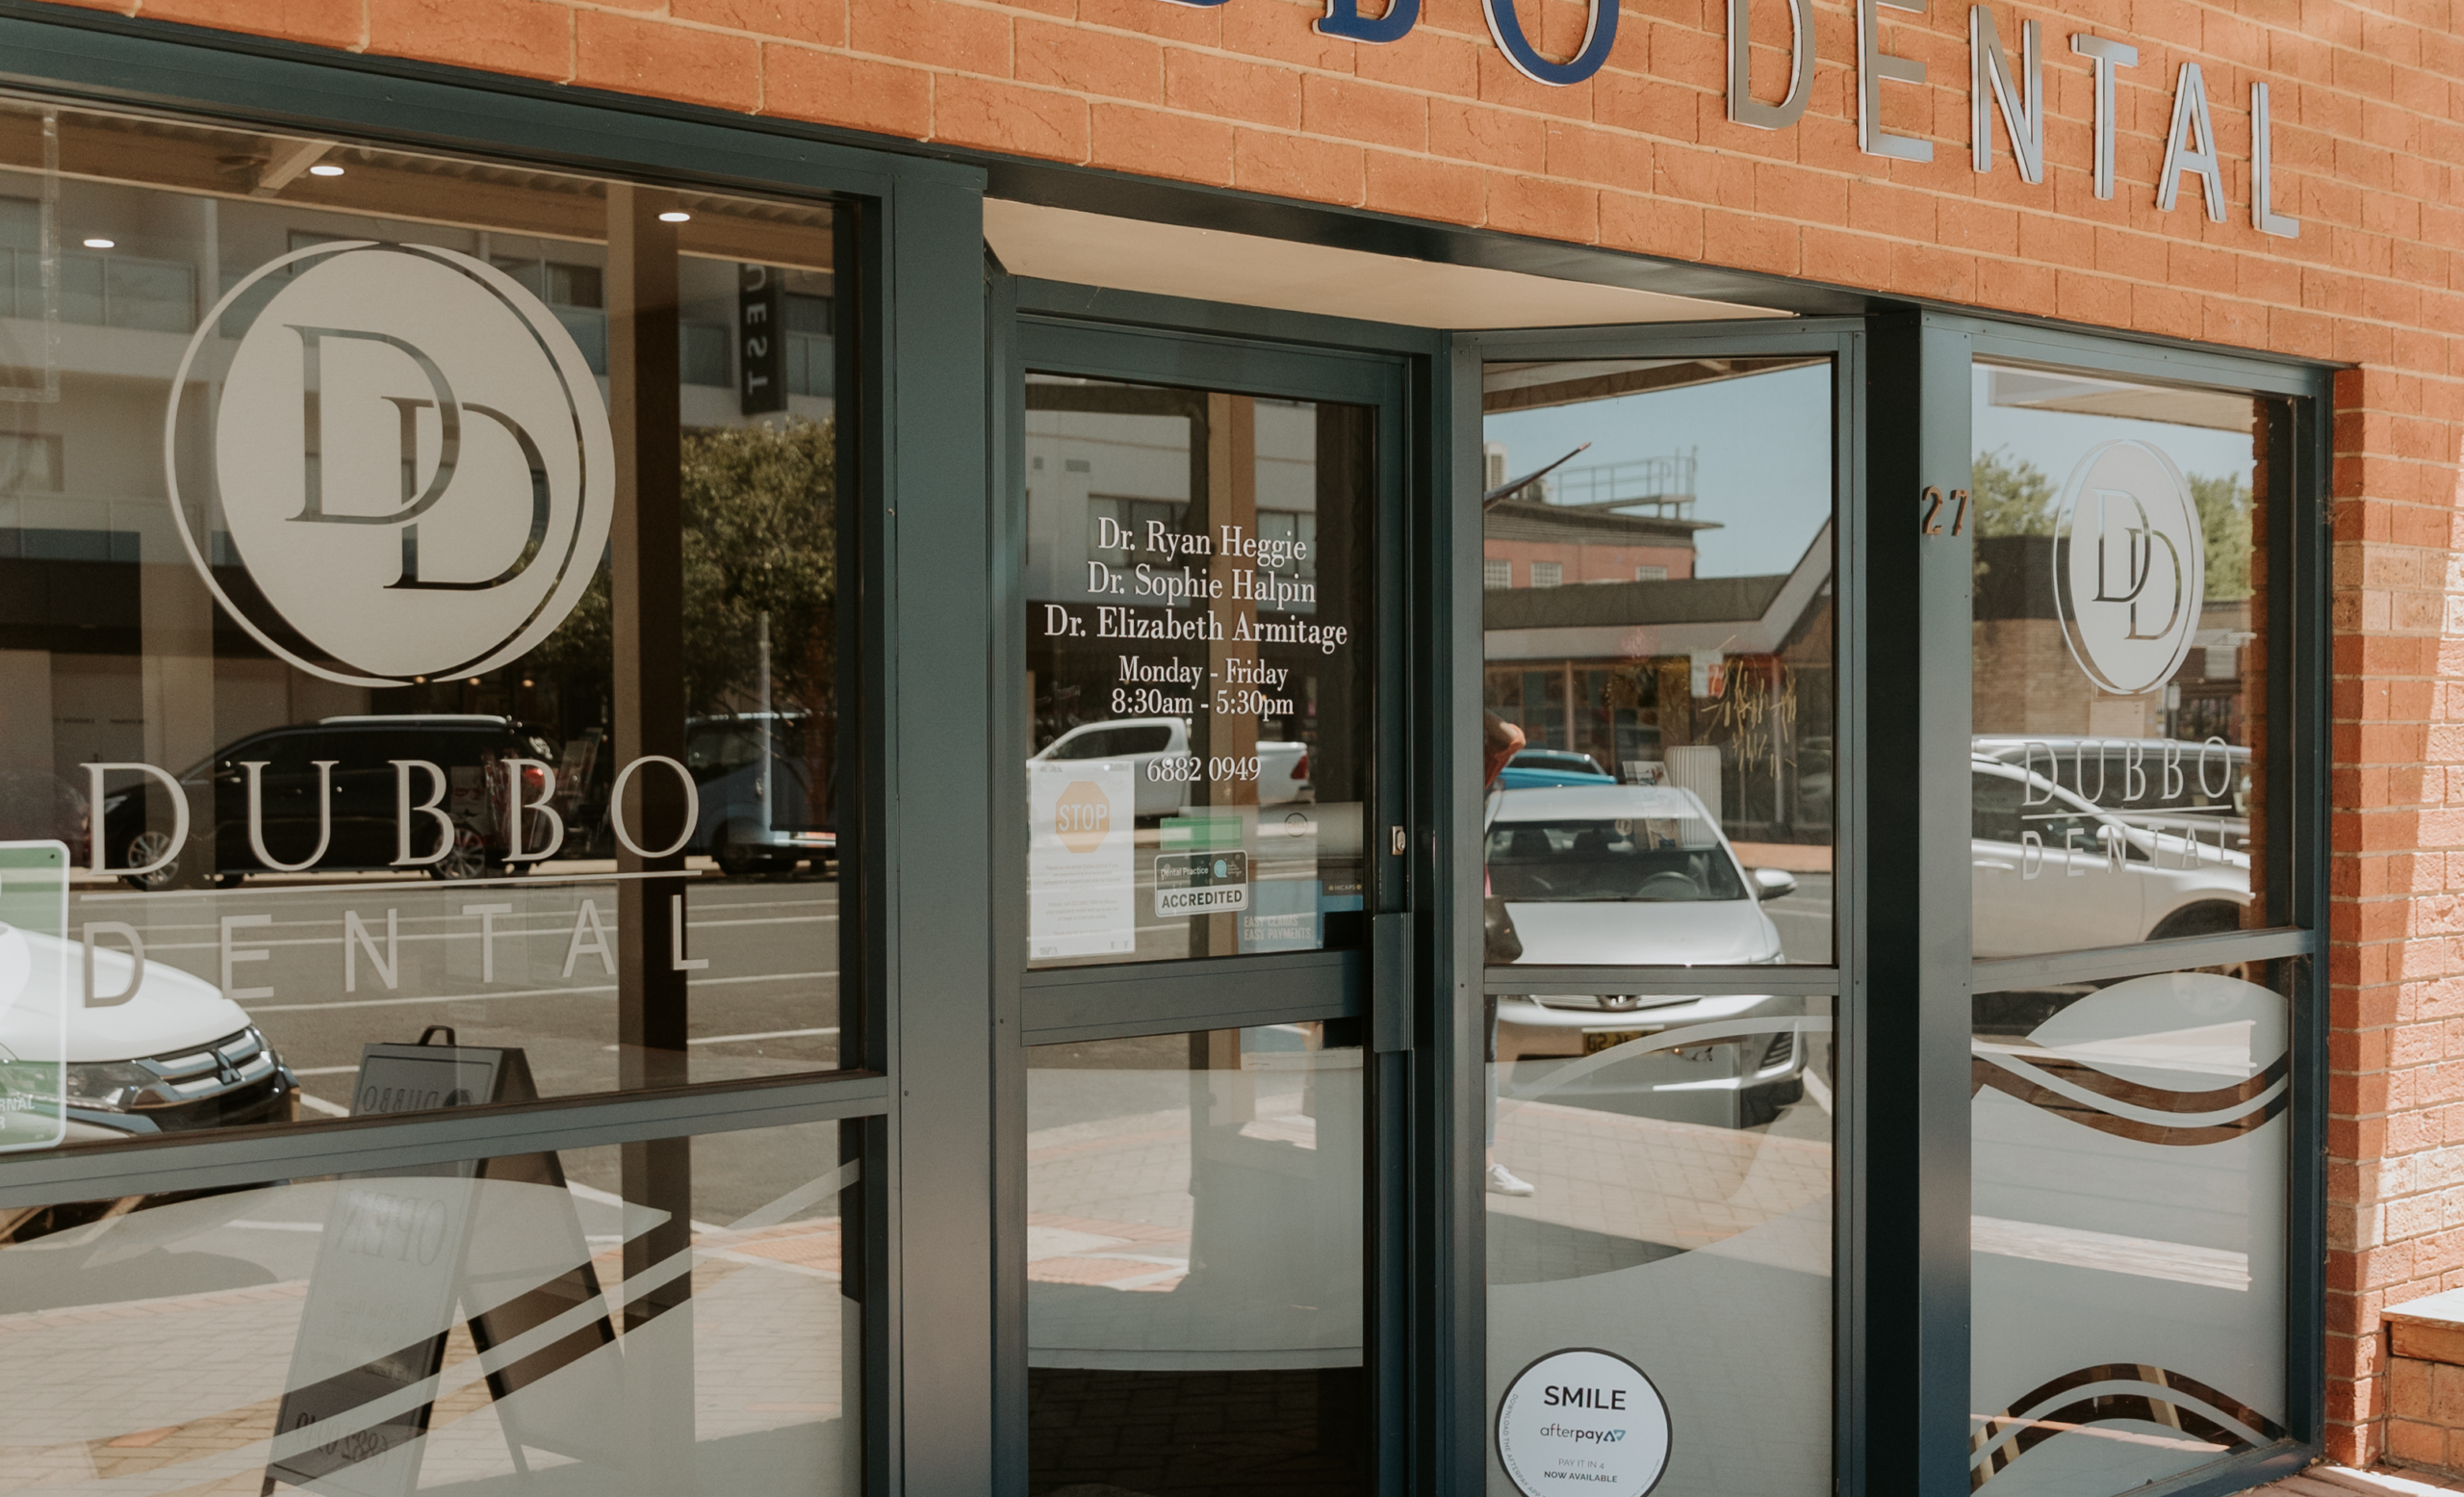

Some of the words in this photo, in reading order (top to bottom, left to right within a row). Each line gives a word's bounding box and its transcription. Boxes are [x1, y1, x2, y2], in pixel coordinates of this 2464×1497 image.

[1728, 0, 2299, 239] DENTAL
[1922, 485, 1969, 536] 27
[1098, 517, 1136, 551] Dr.
[1146, 520, 1211, 561] Ryan
[1220, 525, 1307, 567] Heggie
[1088, 561, 1125, 595] Dr.
[1135, 563, 1223, 606] Sophie
[1232, 569, 1316, 609] Halpin
[1044, 605, 1087, 637] Dr.
[1096, 607, 1224, 640] Elizabeth
[1232, 611, 1348, 655] Armitage
[1118, 655, 1203, 689] Monday
[1225, 658, 1289, 691] Friday
[1112, 688, 1194, 714] 8:30am
[1216, 690, 1295, 721] 5:30pm
[1146, 757, 1202, 782] 6882
[1209, 756, 1261, 782] 0949
[2022, 736, 2232, 806] DUBBO
[80, 756, 700, 877] DUBBO
[1059, 803, 1108, 832] STOP
[2022, 820, 2234, 880] DENTAL
[1161, 867, 1182, 877] Dental
[1183, 866, 1209, 876] Practice
[1162, 890, 1243, 909] ACCREDITED
[1244, 916, 1265, 927] EASY
[1269, 915, 1298, 926] CLAIMS
[1244, 928, 1265, 941] EASY
[1268, 927, 1312, 940] PAYMENTS
[82, 894, 709, 1008] DENTAL
[1544, 1385, 1627, 1410] SMILE
[1502, 1393, 1519, 1436] DOWNLOAD
[1502, 1437, 1512, 1452] THE
[1540, 1423, 1604, 1444] afterpay
[1506, 1453, 1529, 1486] AFTERPAY
[1544, 1471, 1567, 1480] NOW
[1569, 1473, 1618, 1483] AVAILABLE
[1558, 1458, 1576, 1467] PAY
